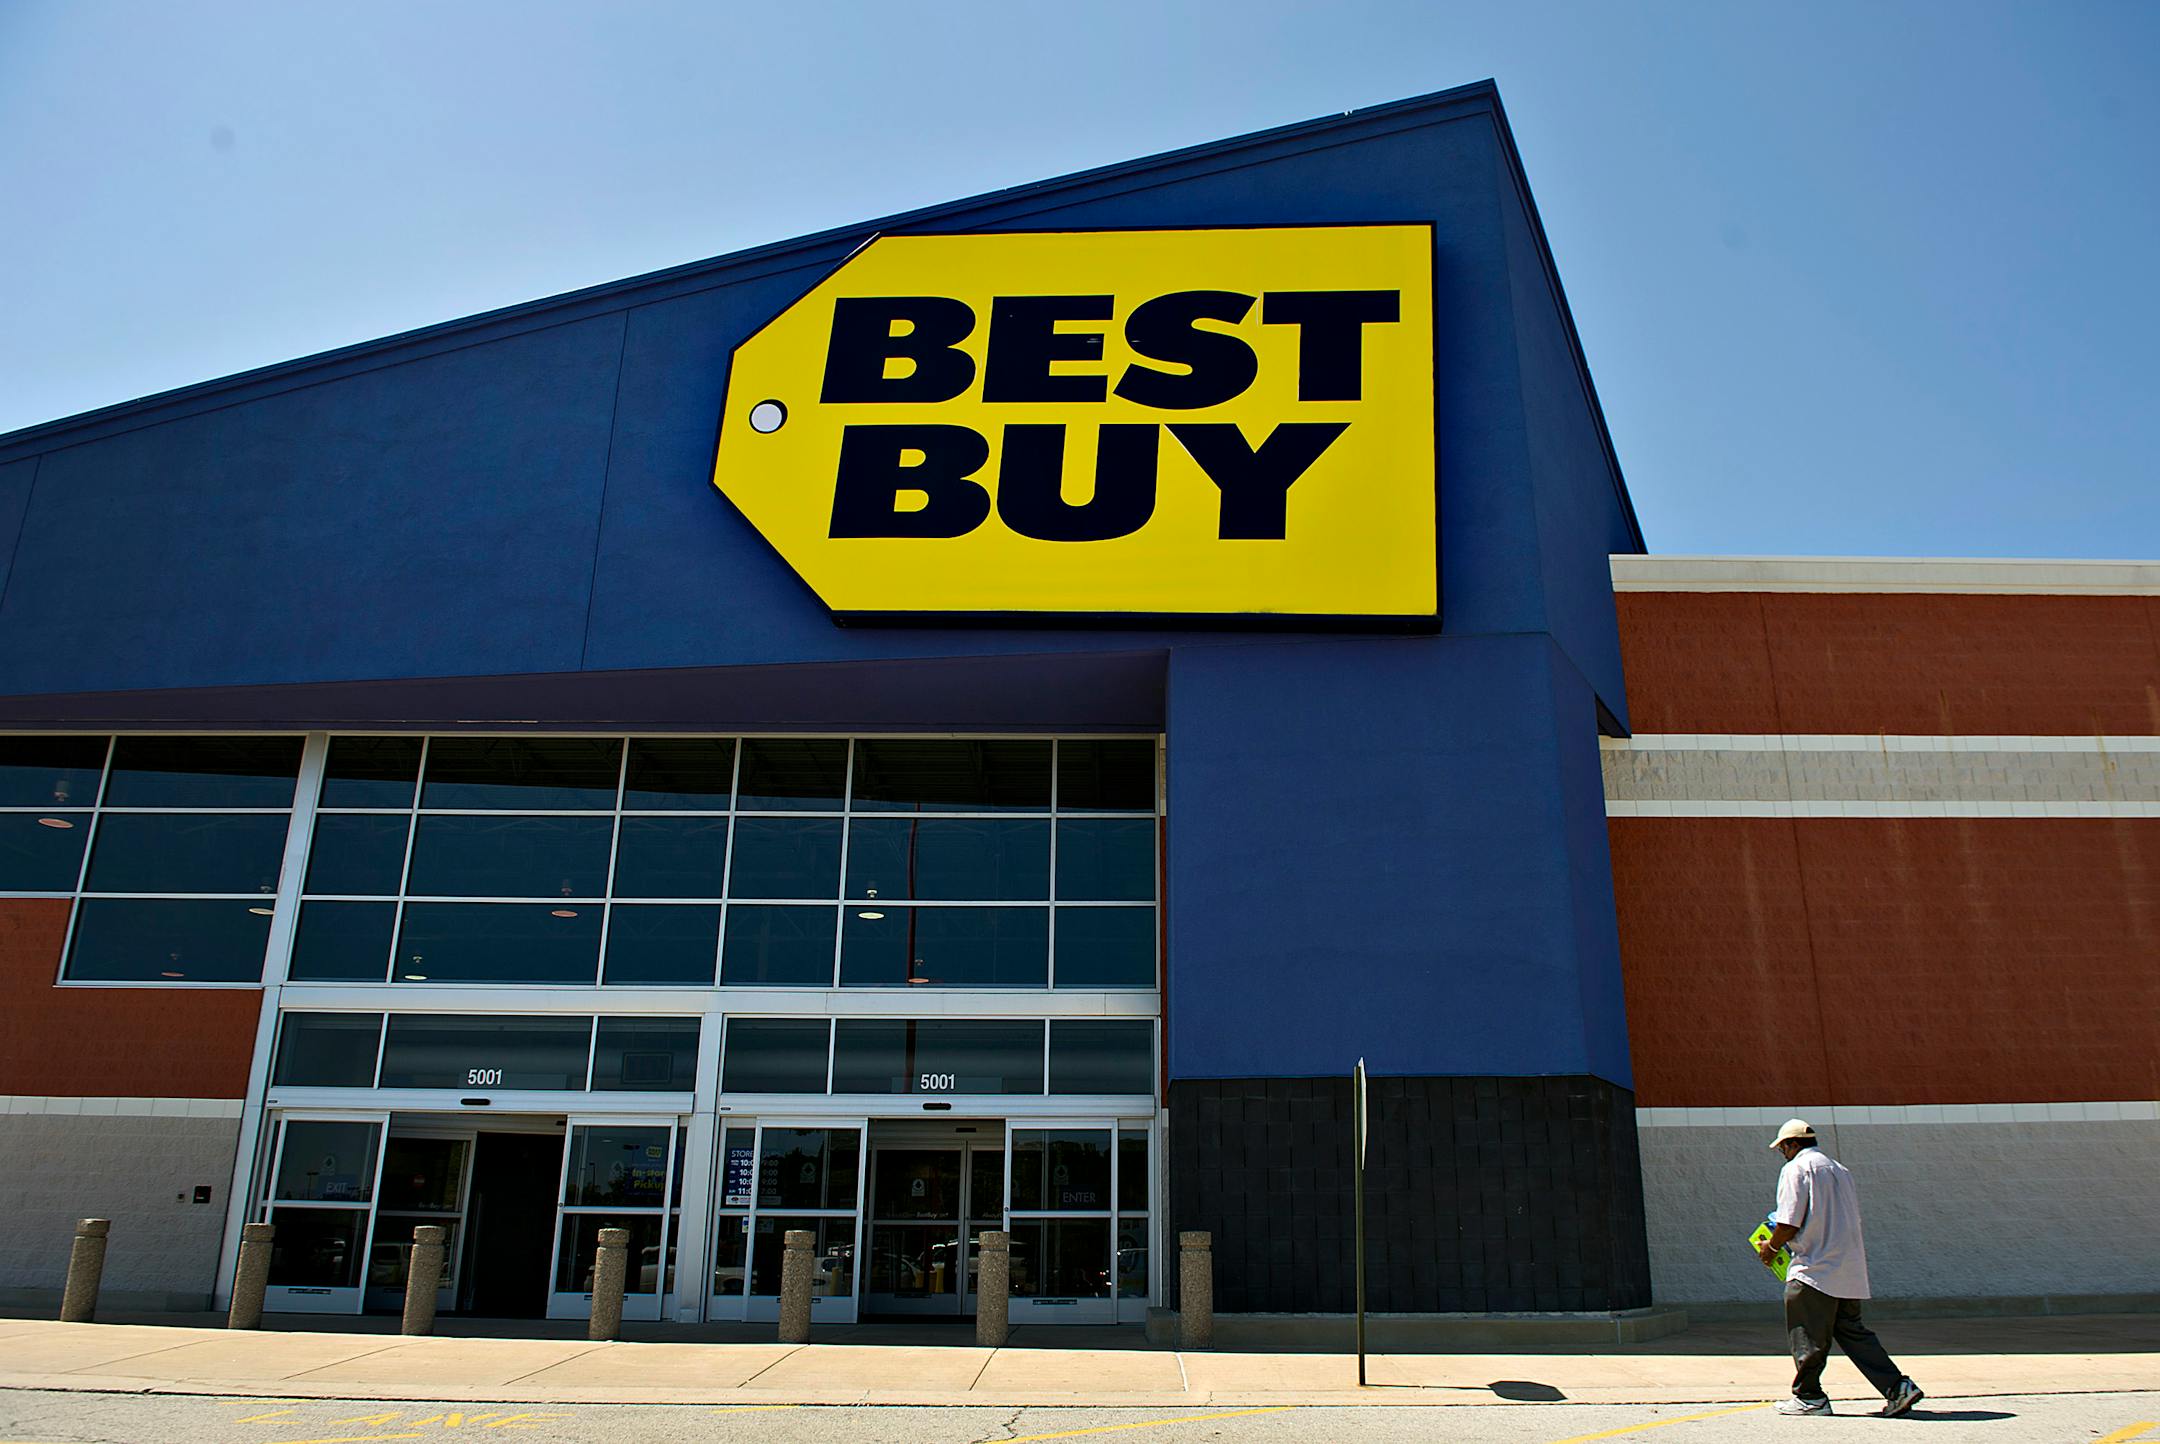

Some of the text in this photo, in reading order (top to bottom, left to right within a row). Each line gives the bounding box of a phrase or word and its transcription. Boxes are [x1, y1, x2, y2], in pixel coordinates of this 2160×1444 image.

[819, 289, 1400, 410] BEST
[827, 422, 1353, 543] BUY
[467, 1067, 503, 1086] 5001
[920, 1073, 956, 1091] 5001
[731, 1150, 754, 1158] STORE
[740, 1159, 754, 1167] 10:0
[326, 1182, 347, 1193] EXIT
[1062, 1191, 1096, 1204] ENTER
